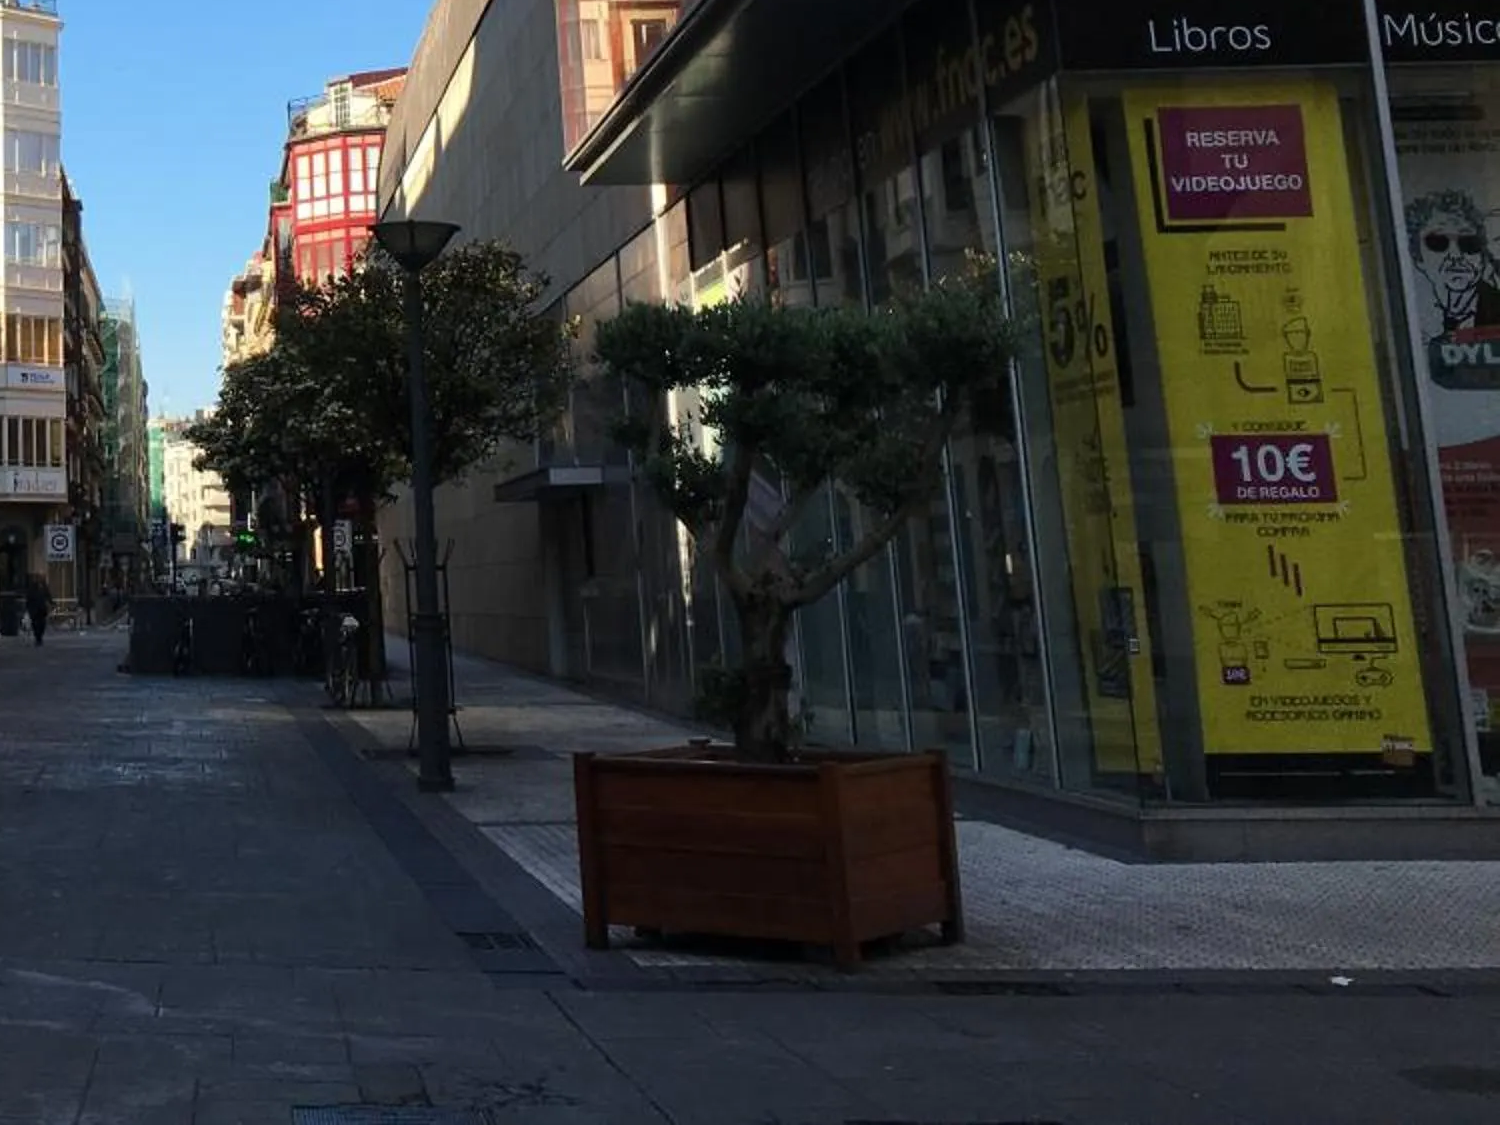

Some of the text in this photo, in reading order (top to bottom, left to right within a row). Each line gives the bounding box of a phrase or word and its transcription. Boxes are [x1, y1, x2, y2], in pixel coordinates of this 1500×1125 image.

[1148, 17, 1272, 53] Libros
[1383, 11, 1500, 47] Músic
[1185, 129, 1281, 148] RESERVA
[1220, 152, 1249, 169] TU
[1171, 174, 1302, 193] VIDEOJUEGO
[1230, 442, 1317, 484] 10€
[1236, 486, 1321, 500] DE REGALO
